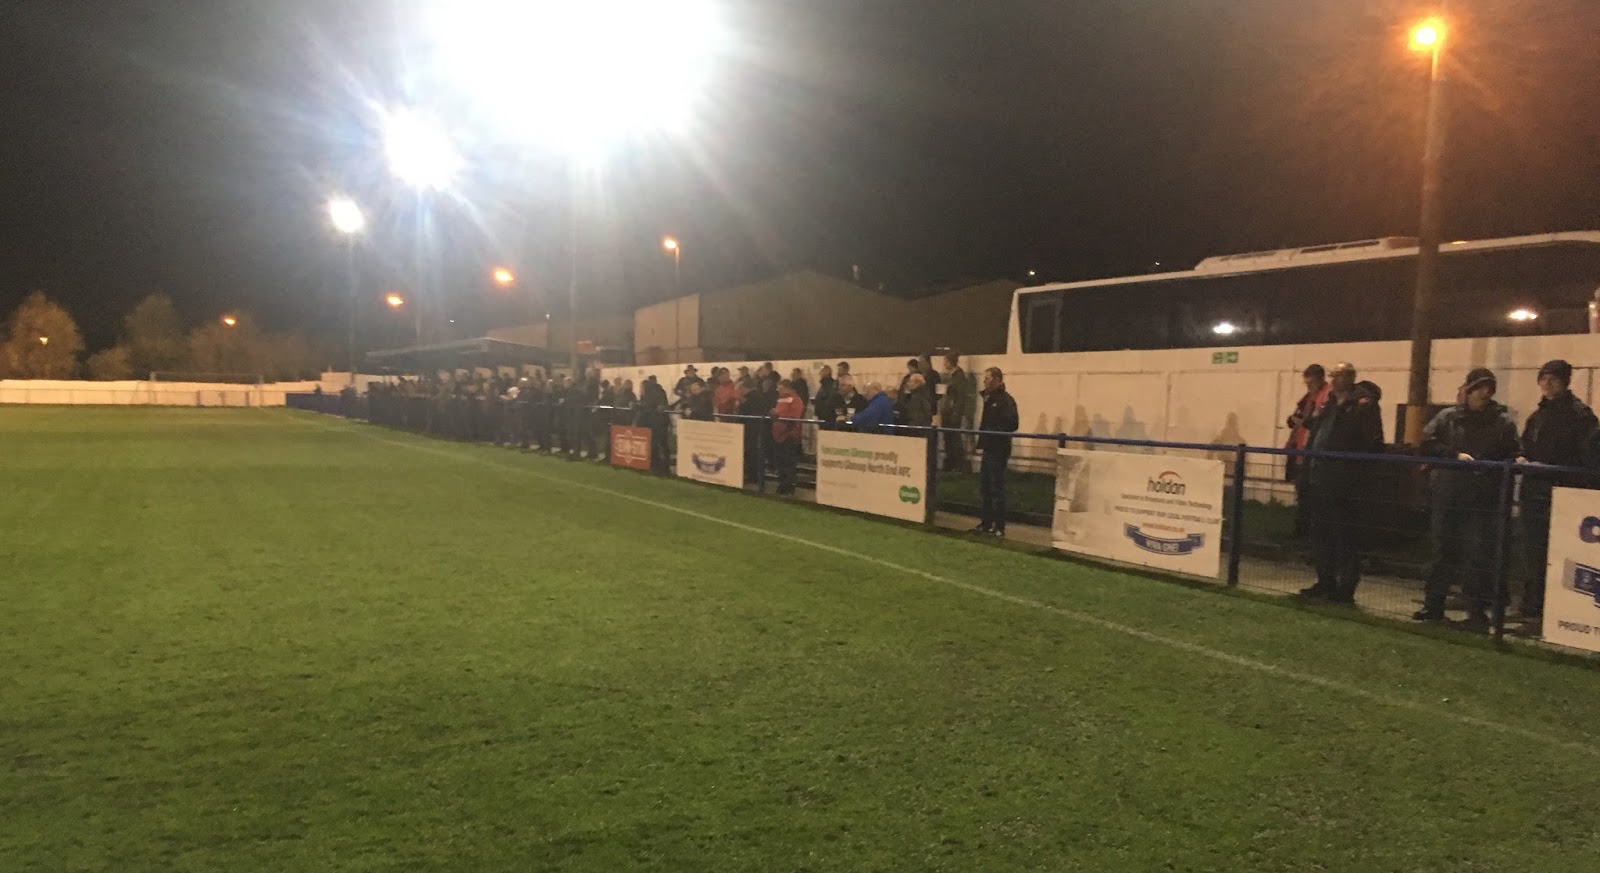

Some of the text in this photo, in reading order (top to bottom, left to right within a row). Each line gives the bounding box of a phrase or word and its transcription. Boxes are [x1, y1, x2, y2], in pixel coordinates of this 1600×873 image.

[898, 466, 911, 478] AFC
[1147, 476, 1186, 495] holdan
[1557, 620, 1592, 634] PROUD
